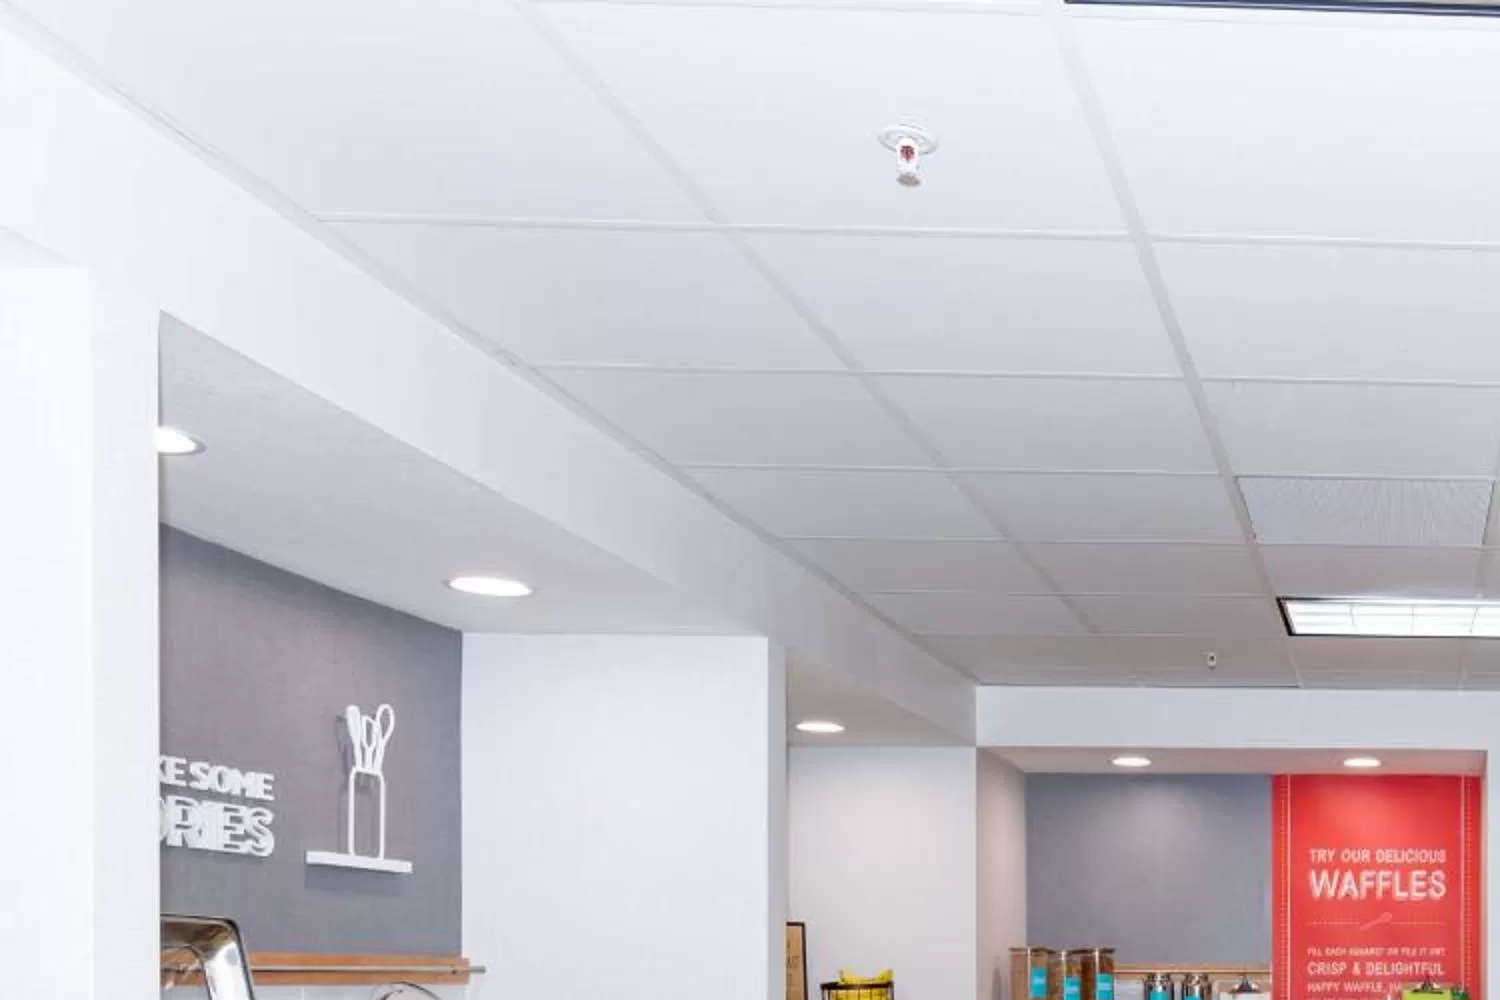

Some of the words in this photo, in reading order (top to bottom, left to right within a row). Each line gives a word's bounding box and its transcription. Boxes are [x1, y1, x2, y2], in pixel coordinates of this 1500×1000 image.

[189, 761, 275, 801] SOME
[1309, 848, 1336, 863] TRY
[1341, 848, 1371, 863] OUR
[1375, 848, 1447, 864] DELICIOUS
[1308, 868, 1447, 900] WAFFLES
[1306, 961, 1347, 976] CRISP
[1352, 961, 1361, 976] &
[1366, 961, 1445, 976] DELIGHTFUL
[1307, 981, 1341, 993] HAPPY
